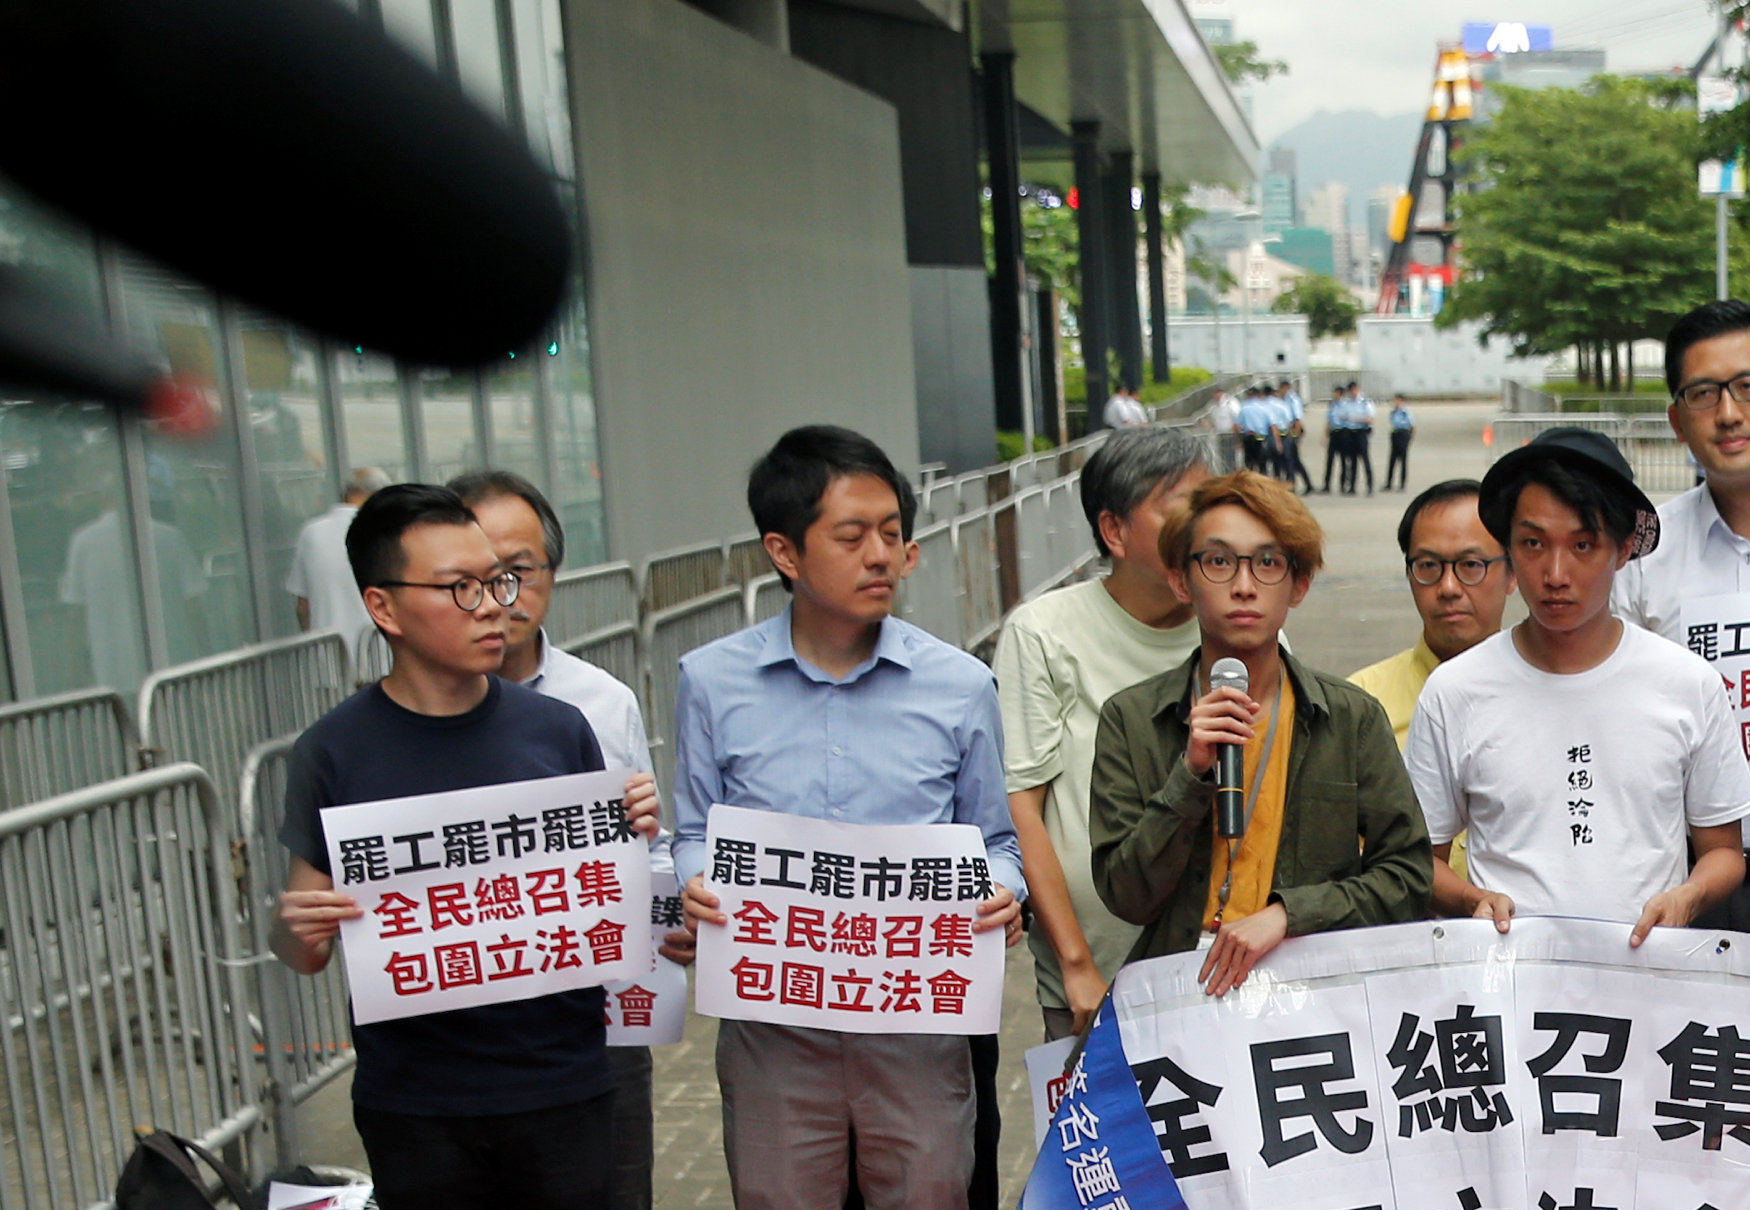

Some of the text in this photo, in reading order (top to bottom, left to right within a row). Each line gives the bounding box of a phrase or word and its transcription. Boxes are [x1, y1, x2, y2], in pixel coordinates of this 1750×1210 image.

[339, 798, 638, 886] 罷工罷市罷課
[711, 837, 996, 902] 罷工罷市罷課
[373, 860, 623, 940] 全民總召集
[732, 900, 974, 959] 全民總召集
[384, 918, 627, 996] 包圍立法會
[730, 956, 973, 1015] 包圍立法會
